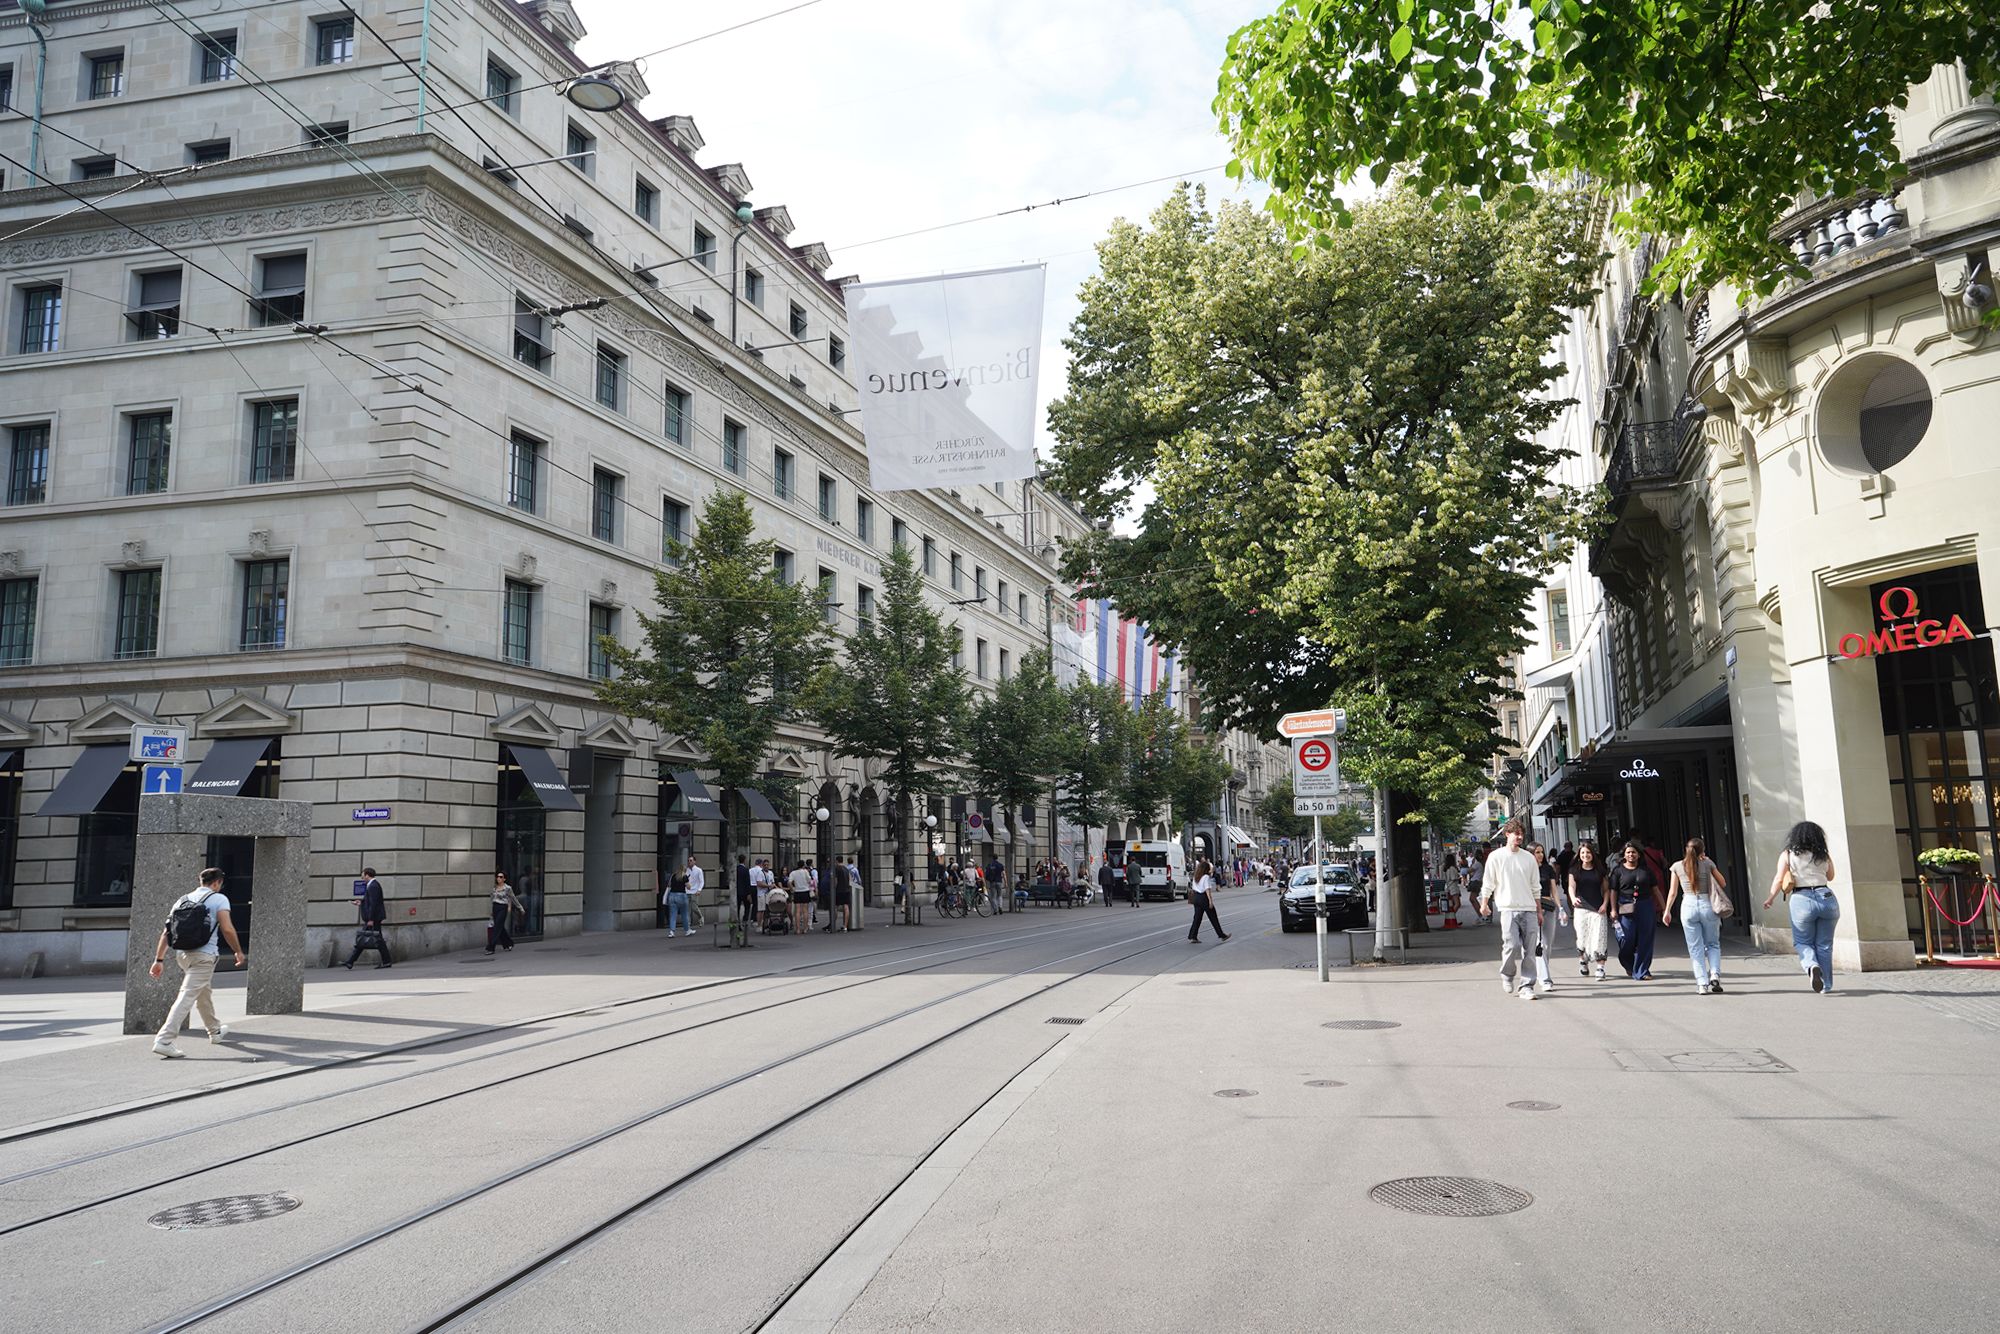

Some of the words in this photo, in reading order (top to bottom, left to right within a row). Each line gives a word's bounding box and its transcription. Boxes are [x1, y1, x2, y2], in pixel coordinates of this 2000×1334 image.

[817, 536, 861, 568] NIEDERER
[864, 560, 881, 577] KRA
[1839, 614, 1977, 659] OMEGA
[1620, 768, 1659, 779] OMEGA
[191, 780, 240, 788] BALENCIAGA
[1297, 802, 1309, 811] ab
[1312, 802, 1324, 811] 50
[1327, 803, 1335, 811] m
